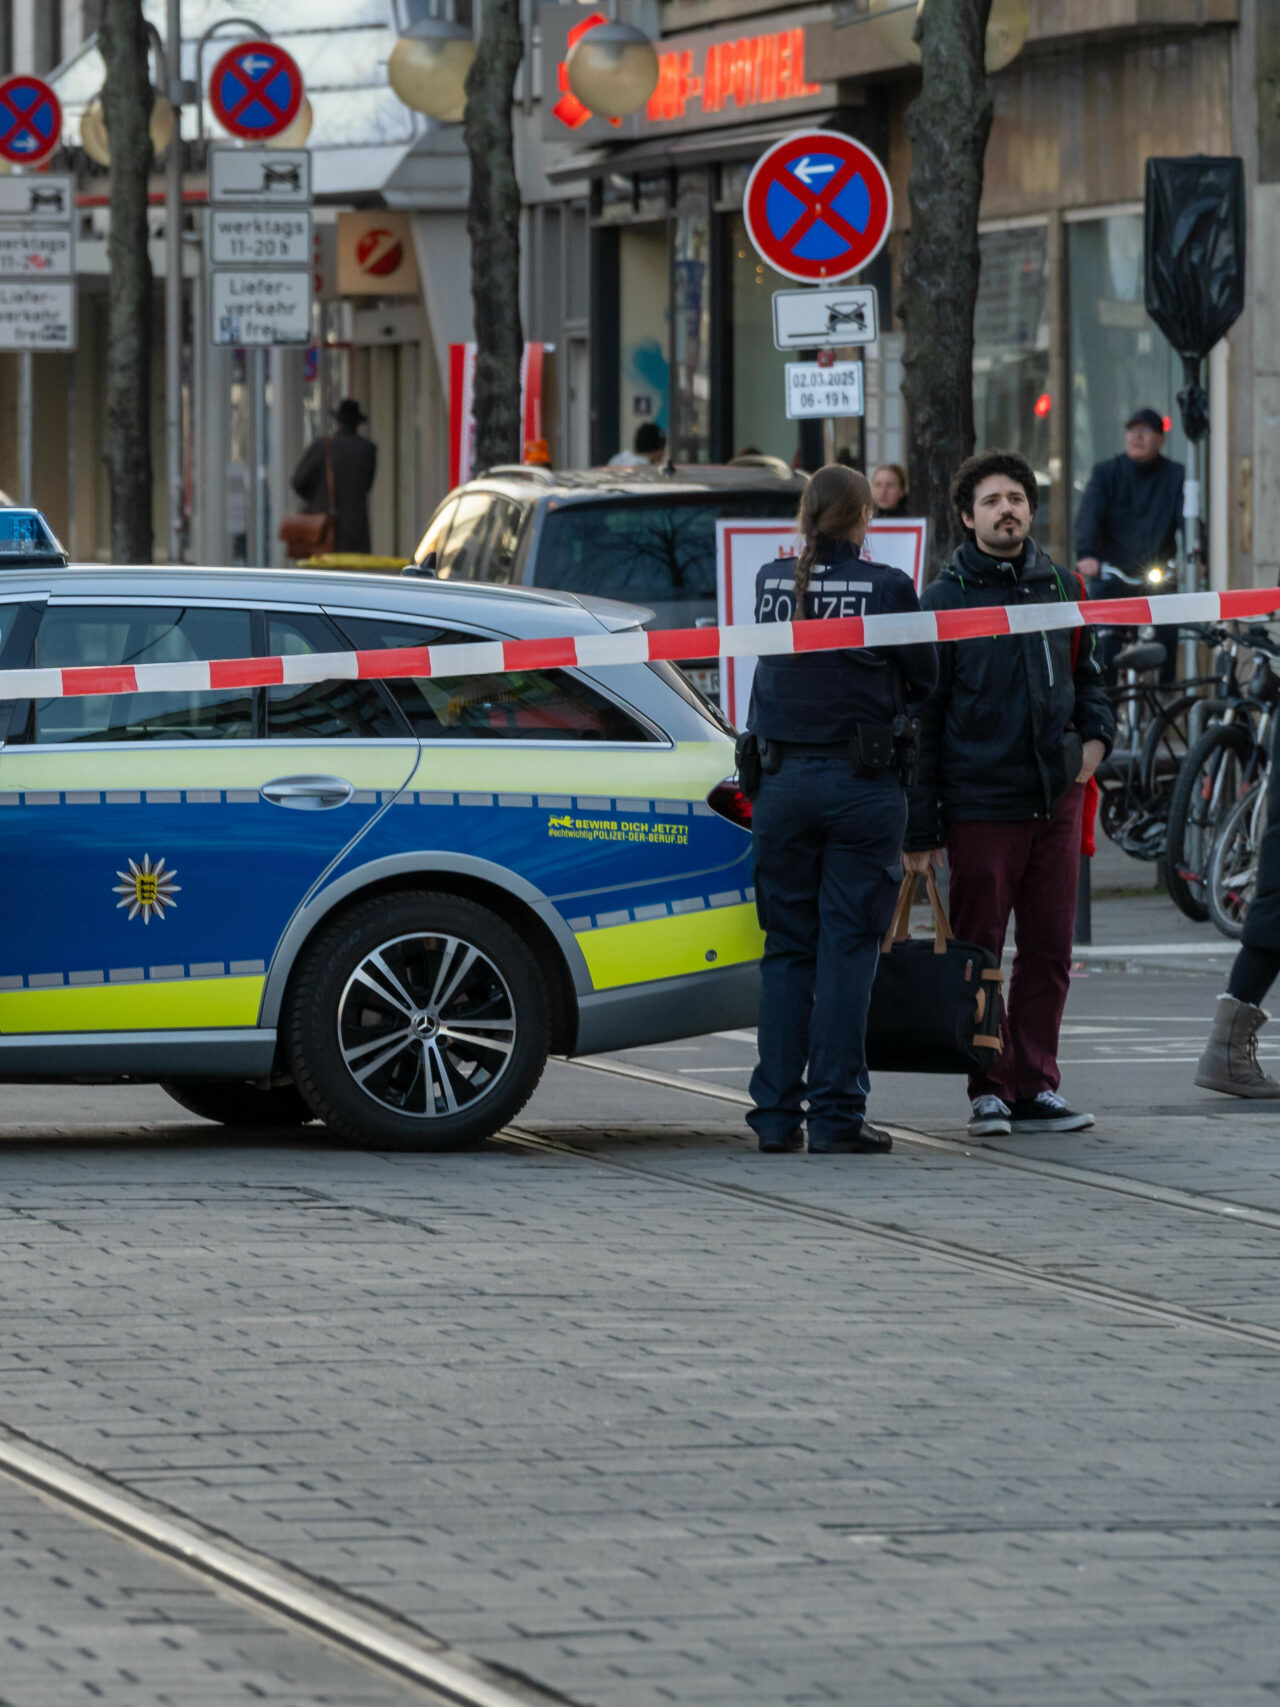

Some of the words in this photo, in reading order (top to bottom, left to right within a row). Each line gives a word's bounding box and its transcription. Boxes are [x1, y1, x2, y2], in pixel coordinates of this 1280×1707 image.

[217, 219, 304, 239] werktags
[231, 240, 276, 256] 11-20
[281, 239, 289, 256] h
[228, 279, 292, 295] Liefer-
[0, 288, 57, 305] Liefer-
[224, 300, 296, 317] verkehr
[246, 321, 278, 337] frei
[793, 371, 855, 389] 02.03.2025
[800, 393, 815, 408] 06
[825, 392, 839, 407] 19
[841, 391, 850, 405] h
[759, 593, 867, 623] POIZEI
[575, 819, 618, 831] BEWIRB
[621, 821, 649, 833] DICH
[651, 823, 689, 835] JETZT!
